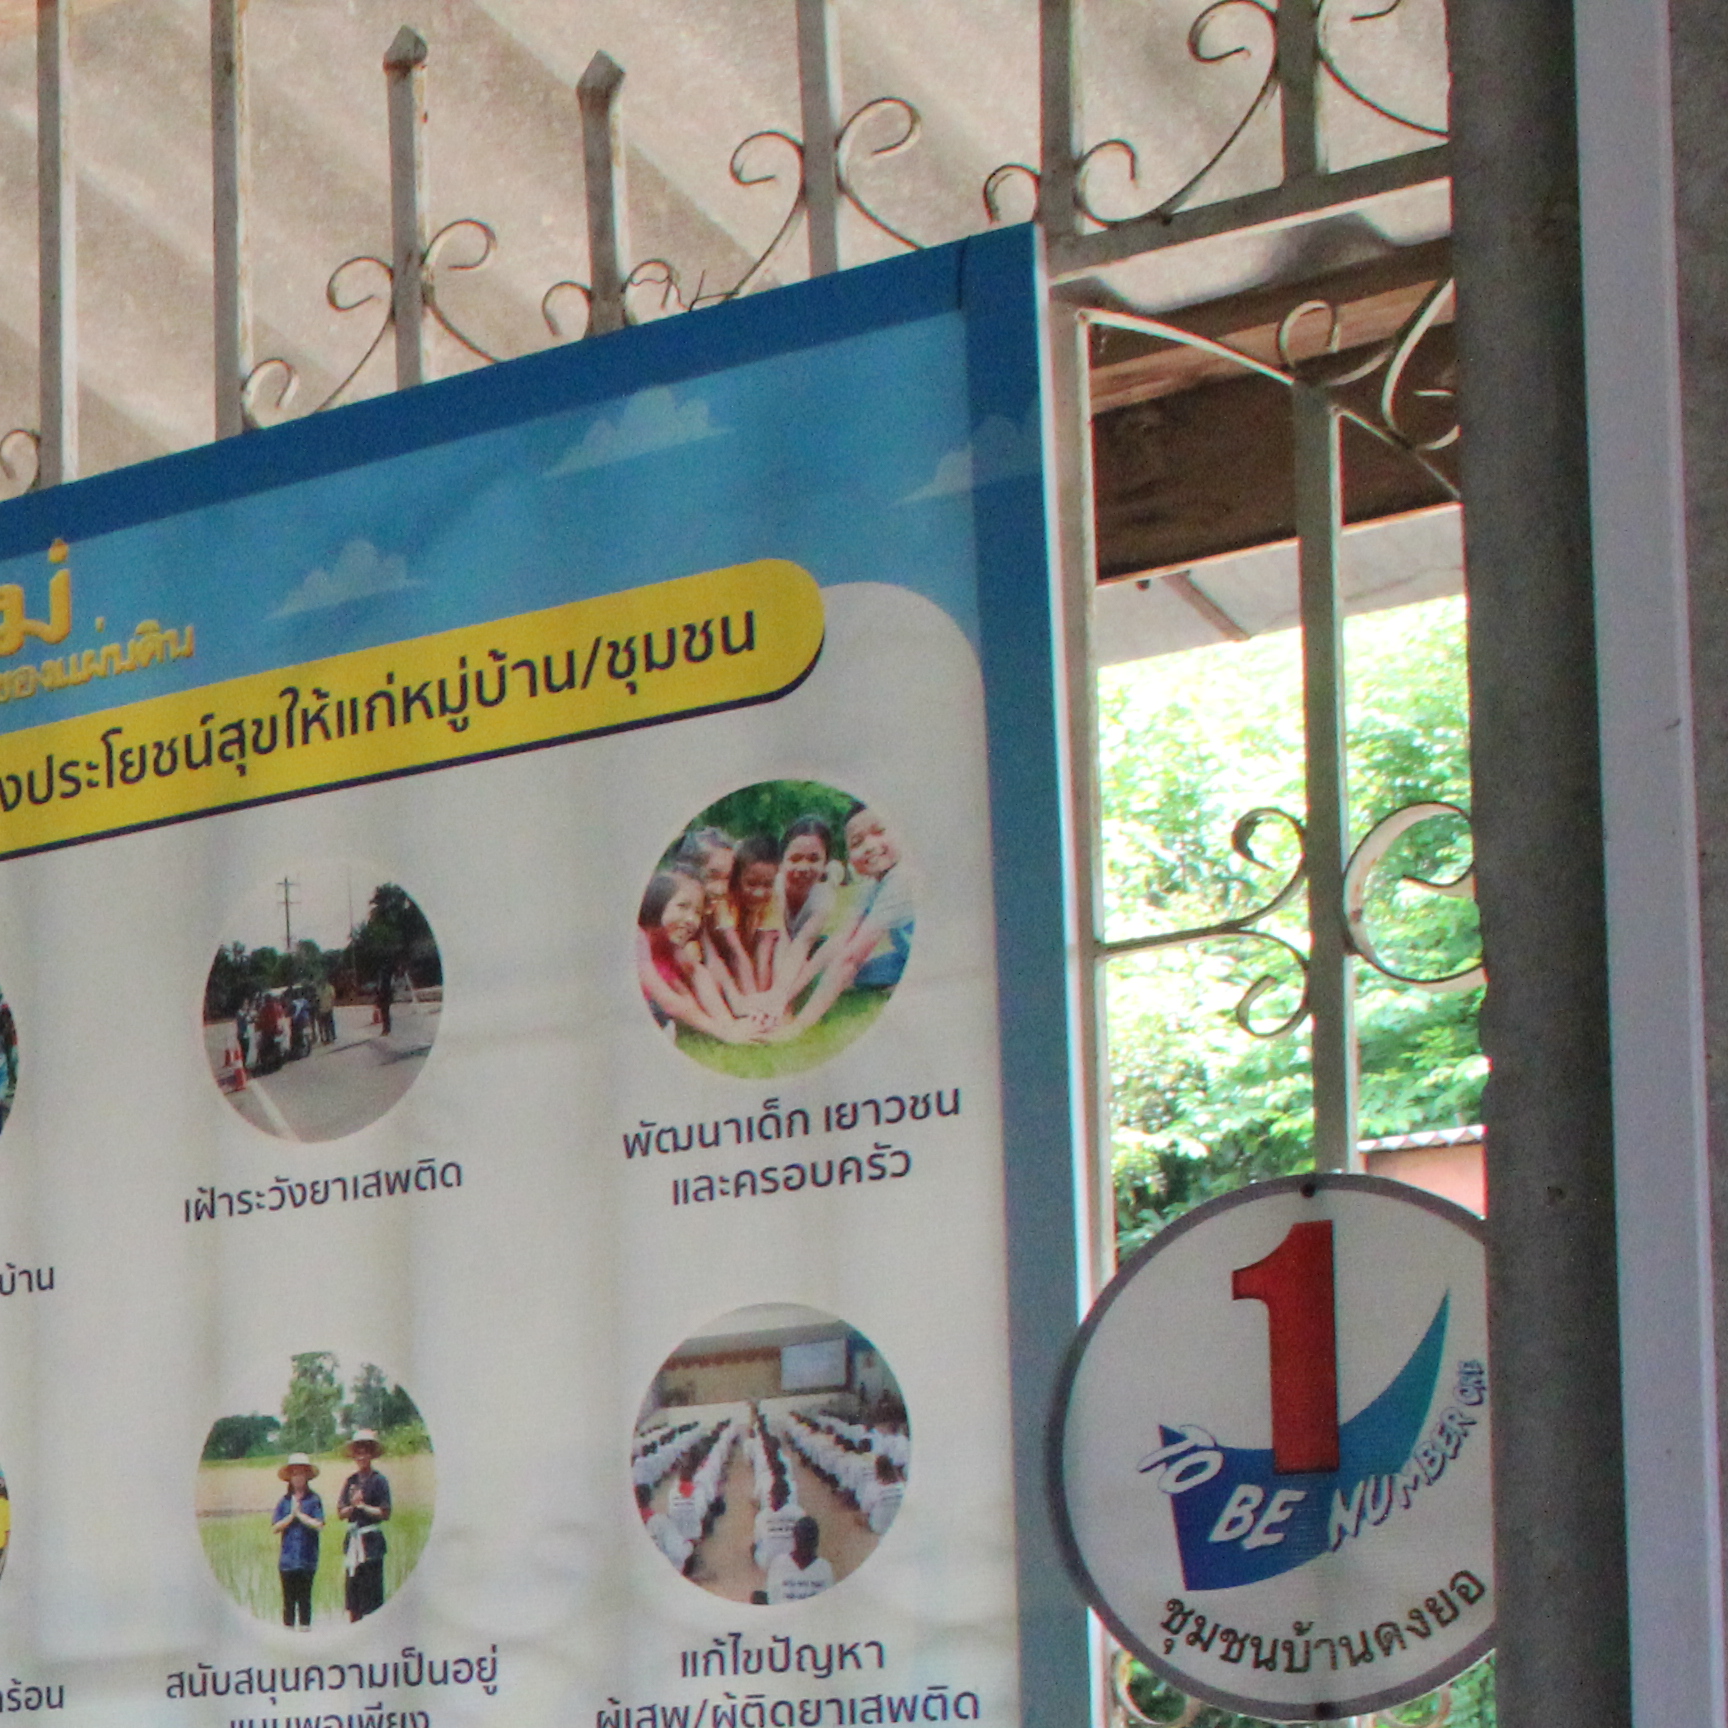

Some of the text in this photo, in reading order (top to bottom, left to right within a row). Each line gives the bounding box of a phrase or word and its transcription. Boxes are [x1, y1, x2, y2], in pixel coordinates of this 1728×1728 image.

[623, 1086, 962, 1160] พัฒนาเด็ก เยาวชน
[184, 1156, 464, 1224] เฝ้าระวังยาเสพติด
[672, 1141, 913, 1207] และครอบครัว
[1232, 1220, 1340, 1474] 1
[1137, 1424, 1225, 1495] TO
[1208, 1484, 1307, 1550] BE
[1327, 1406, 1478, 1552] NUMBER
[166, 1644, 500, 1706] สนับสนุนความเป็นอยู่
[680, 1632, 886, 1680] แก้ไขปัญหา
